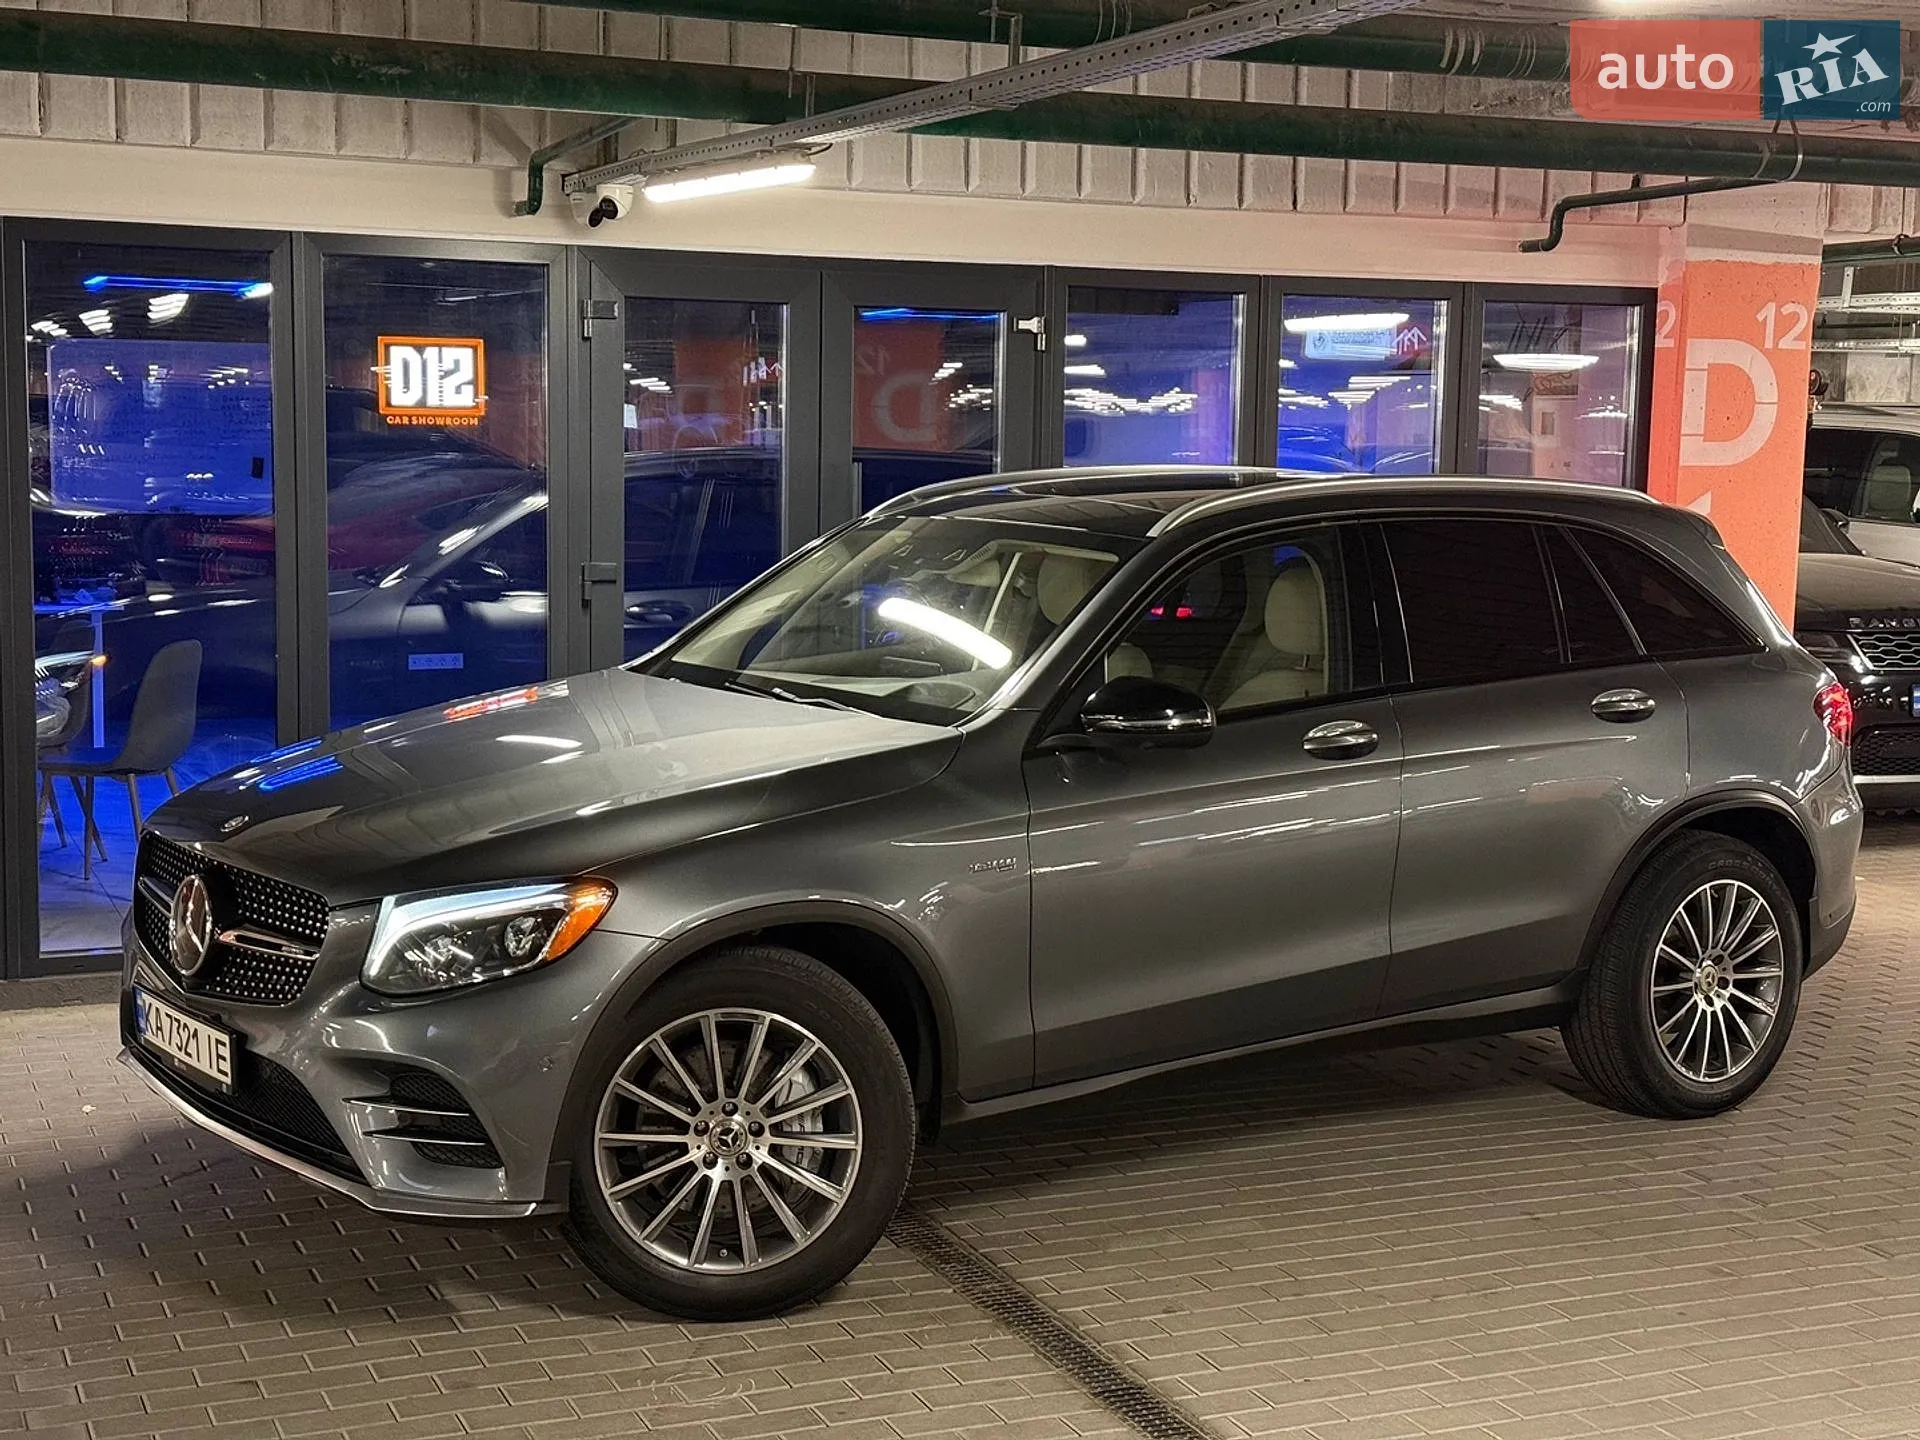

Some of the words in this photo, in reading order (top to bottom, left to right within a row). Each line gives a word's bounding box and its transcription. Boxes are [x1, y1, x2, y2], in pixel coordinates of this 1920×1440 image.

[1755, 301, 1809, 350] 12
[390, 345, 474, 407] D12
[386, 415, 409, 426] CAR
[411, 415, 479, 426] SHOWROOM
[1680, 338, 1778, 467] D
[1848, 616, 1920, 629] RANG
